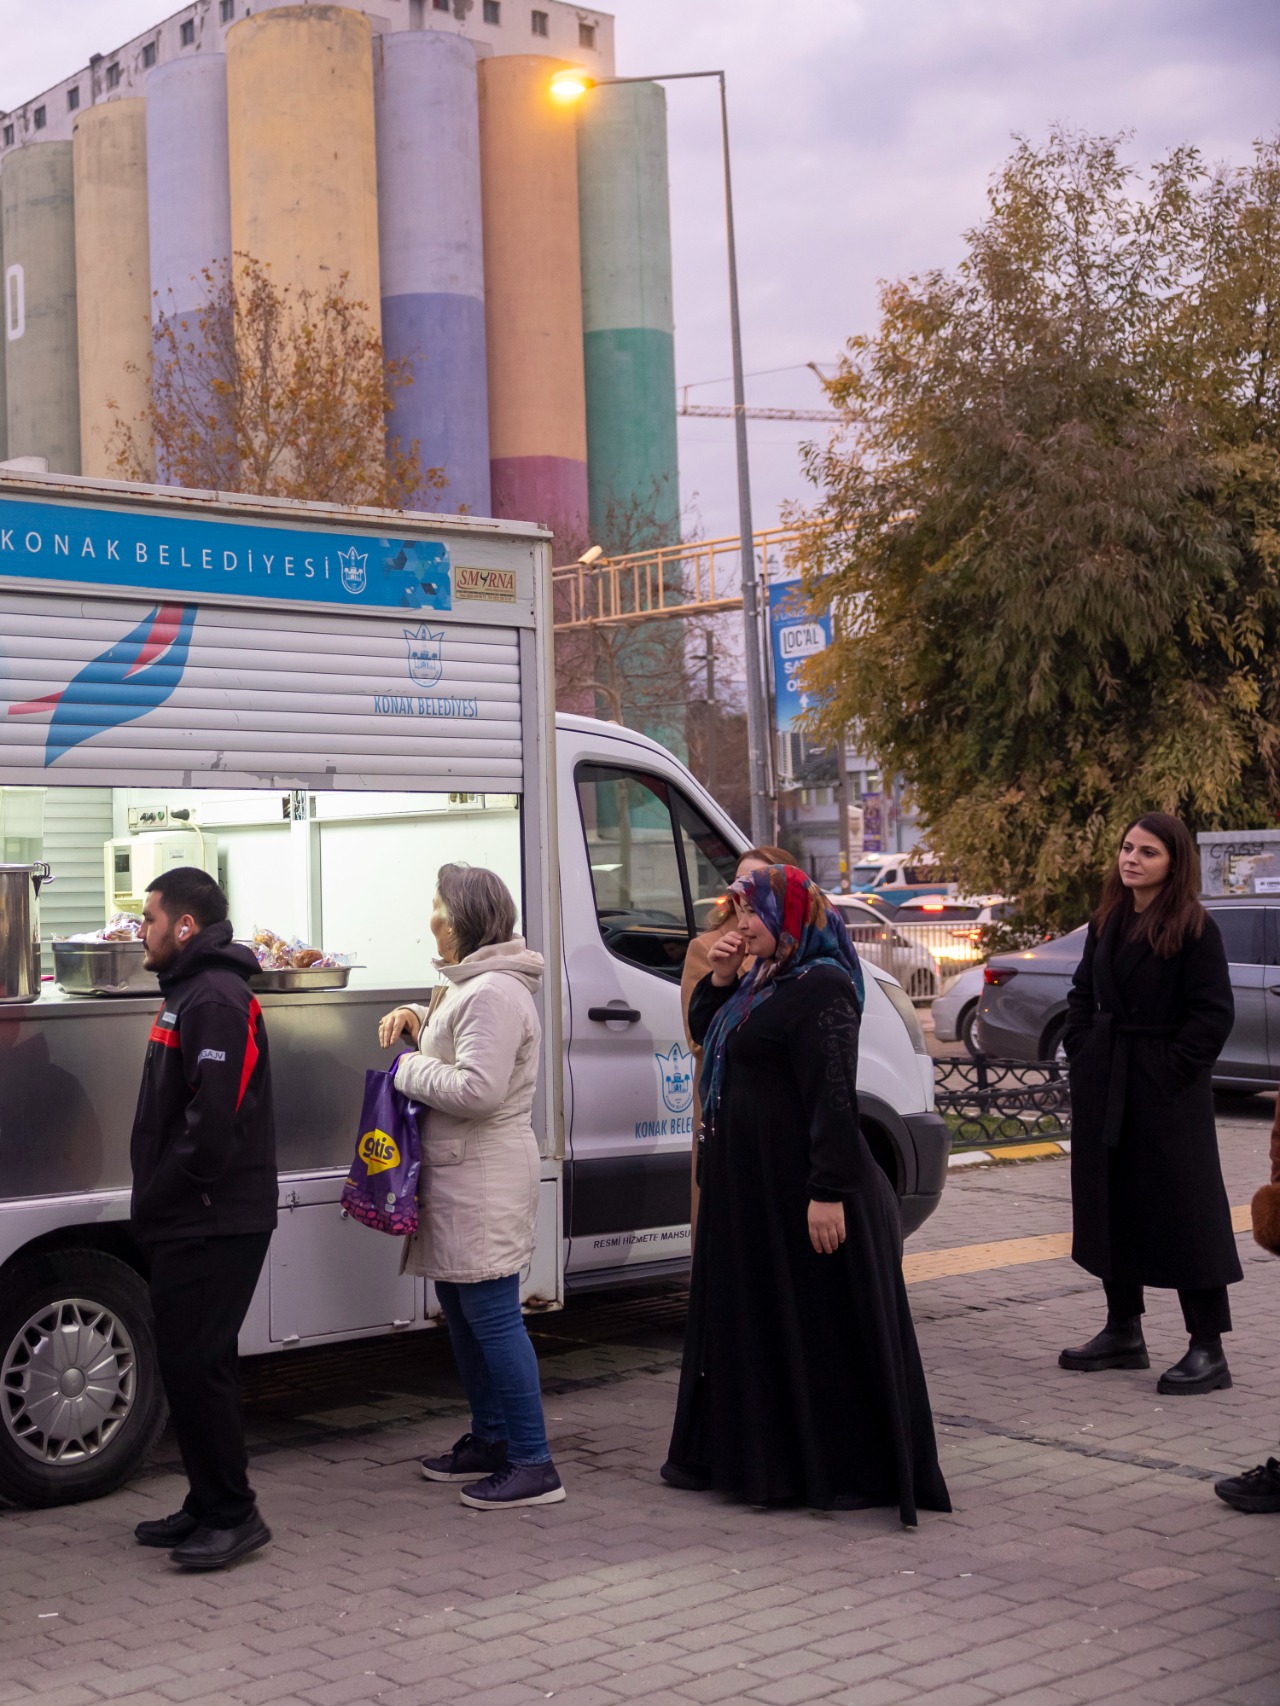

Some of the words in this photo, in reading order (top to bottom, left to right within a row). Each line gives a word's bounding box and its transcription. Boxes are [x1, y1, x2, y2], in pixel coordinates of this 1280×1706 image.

[1, 529, 120, 561] KONAK
[135, 542, 329, 579] BELEDİYESİ
[457, 569, 514, 589] SMYRNA
[374, 695, 414, 714] KONAK
[418, 695, 478, 717] BELEDİYESİ
[635, 1120, 667, 1138] KONAK
[593, 1236, 620, 1248] RESMİ
[622, 1233, 658, 1245] HİZMETE
